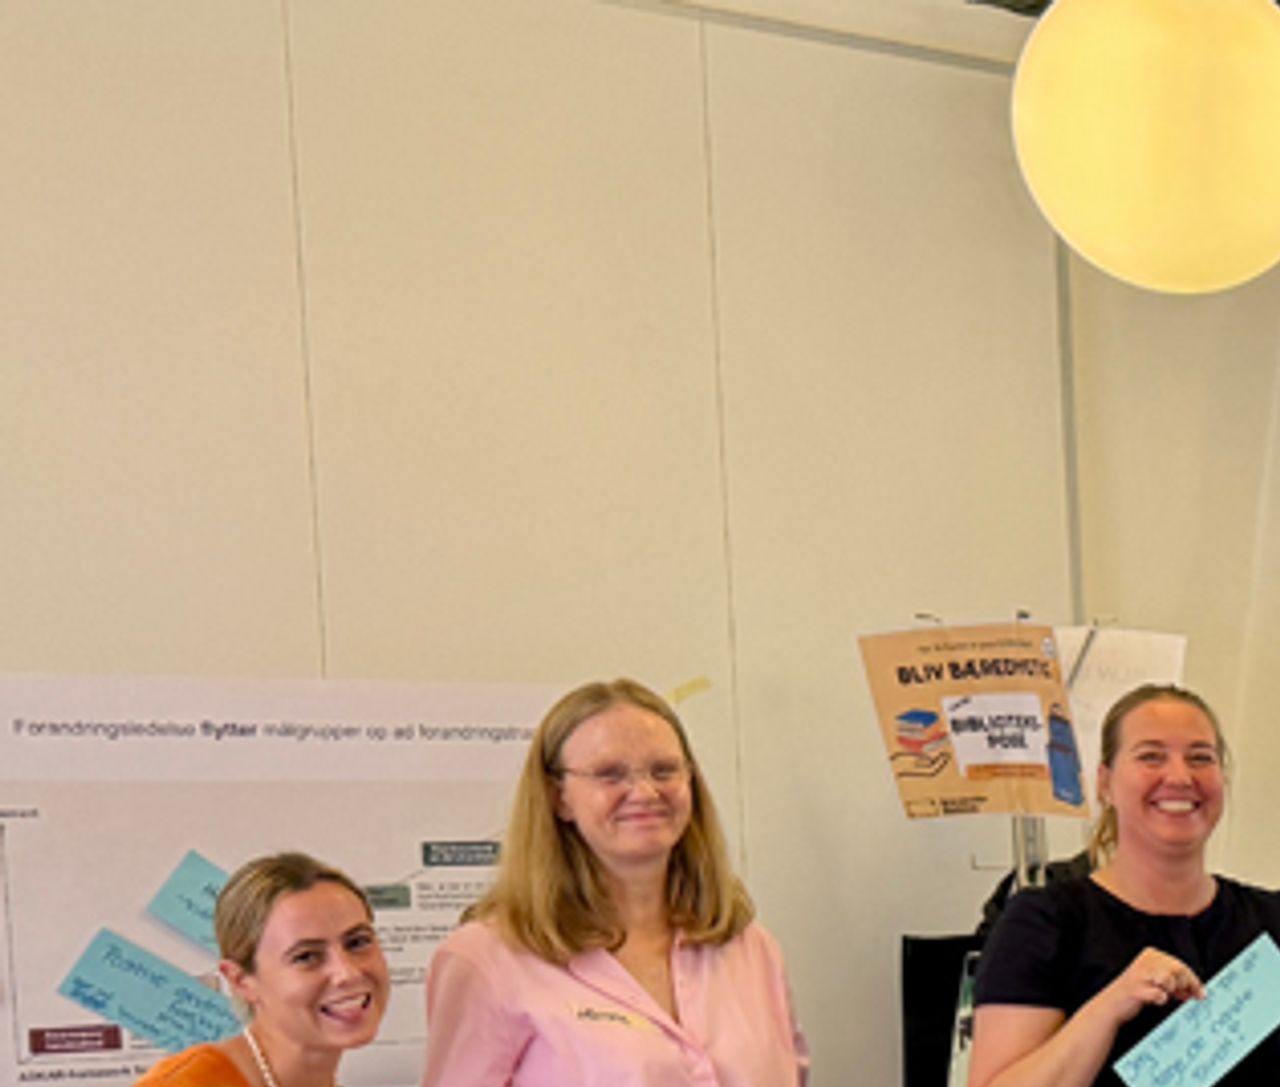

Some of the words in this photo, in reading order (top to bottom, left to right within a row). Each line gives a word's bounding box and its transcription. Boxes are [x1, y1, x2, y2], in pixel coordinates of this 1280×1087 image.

[896, 662, 944, 685] BLIV
[201, 718, 259, 742] flytter
[419, 723, 534, 745] forandringstra
